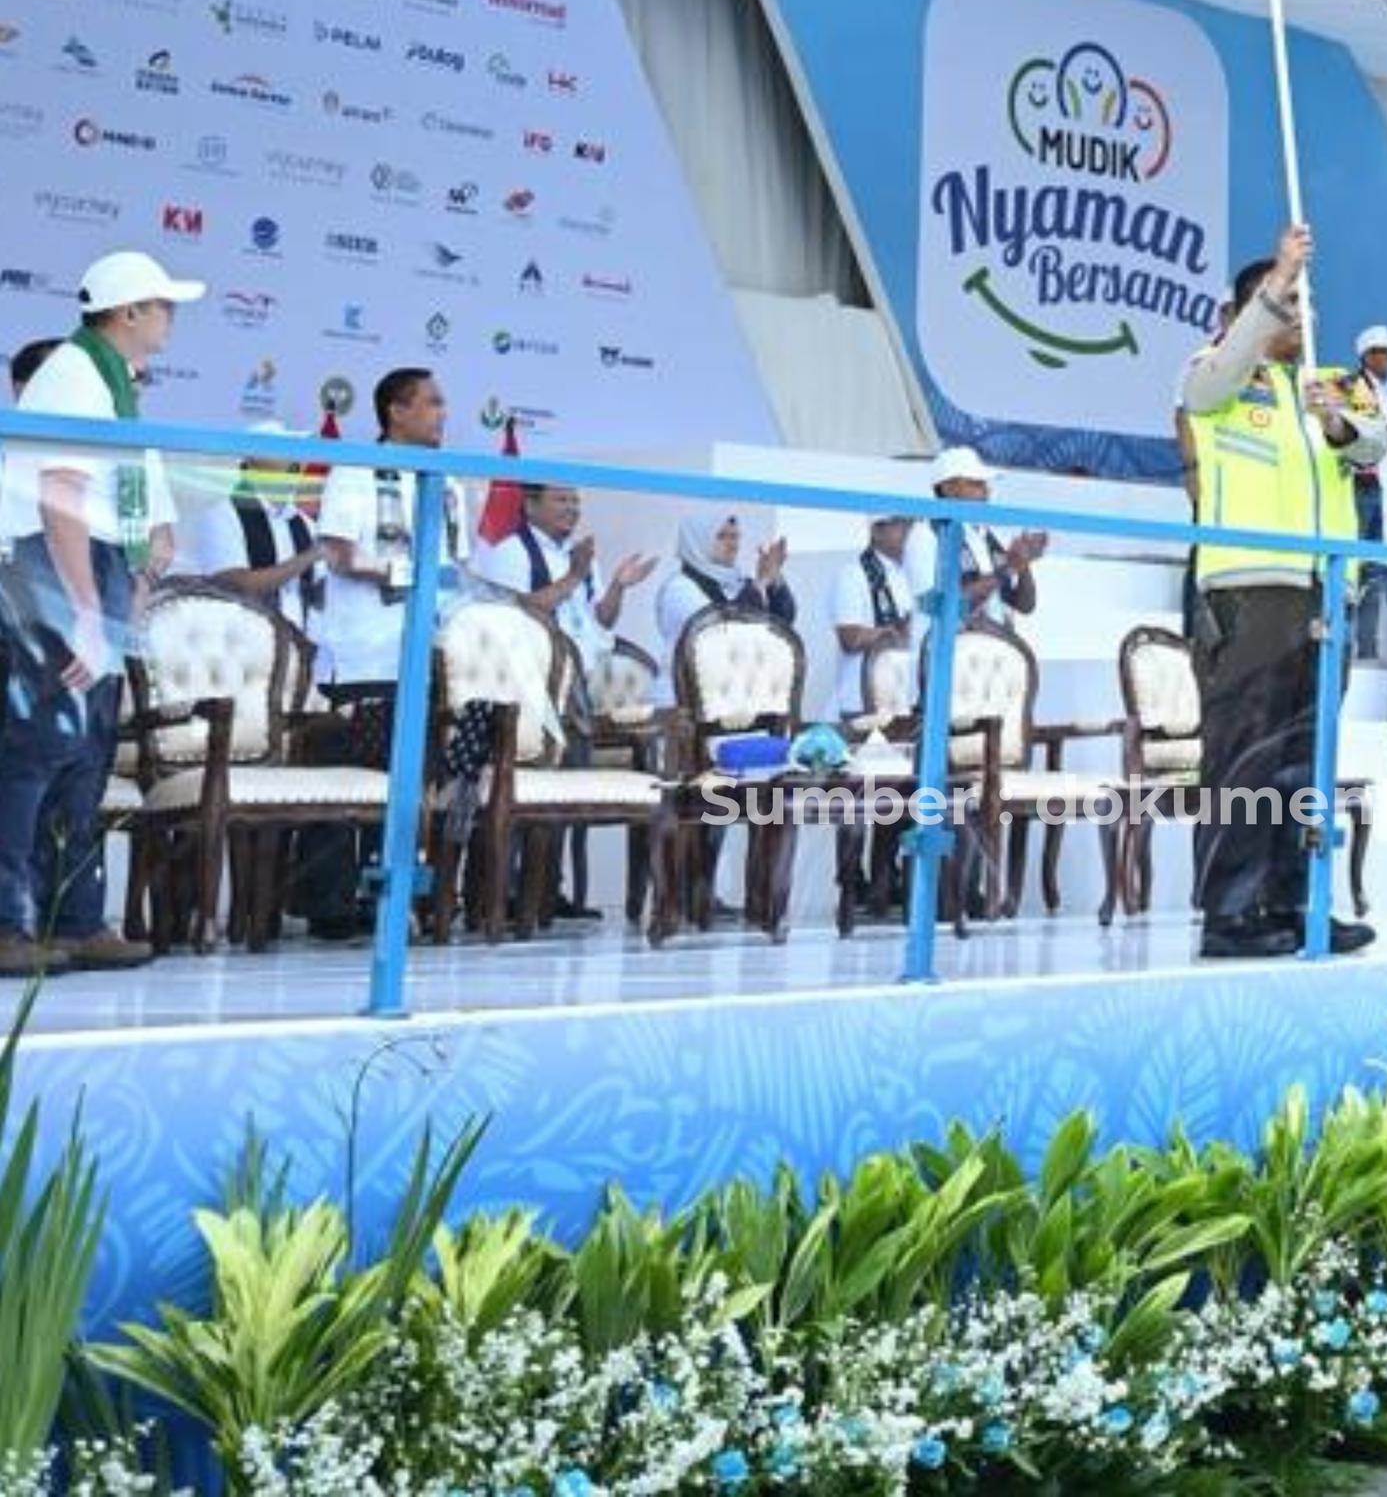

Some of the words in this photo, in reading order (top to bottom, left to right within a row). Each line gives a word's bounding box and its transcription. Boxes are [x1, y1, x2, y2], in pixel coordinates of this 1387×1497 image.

[1039, 126, 1142, 183] MUDIK
[932, 165, 1209, 276] Nyaman
[1028, 245, 1224, 334] Bersama
